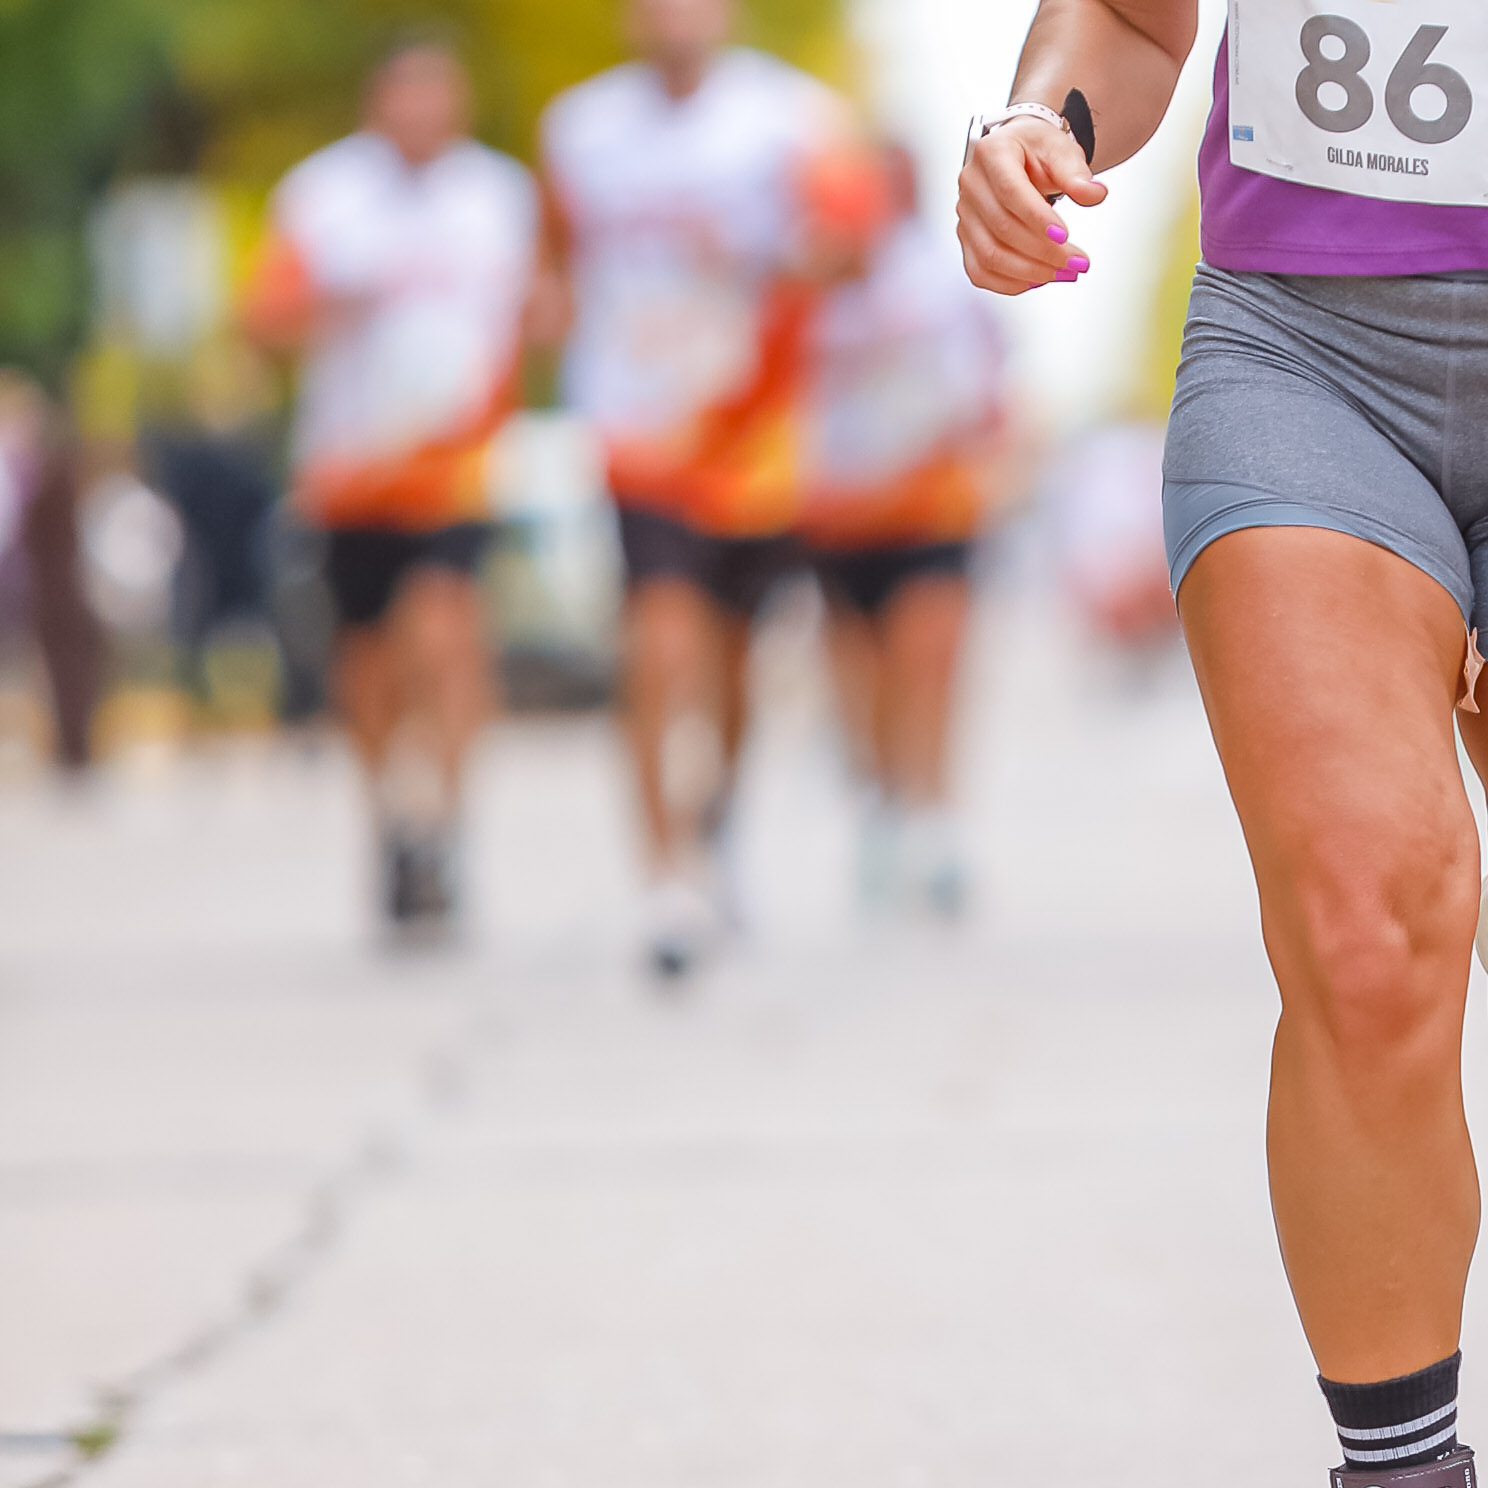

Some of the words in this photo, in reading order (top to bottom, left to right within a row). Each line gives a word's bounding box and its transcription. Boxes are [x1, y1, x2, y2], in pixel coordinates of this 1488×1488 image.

[1295, 14, 1473, 144] 86
[1327, 146, 1363, 169] GILDA
[1366, 152, 1429, 176] MORALES
